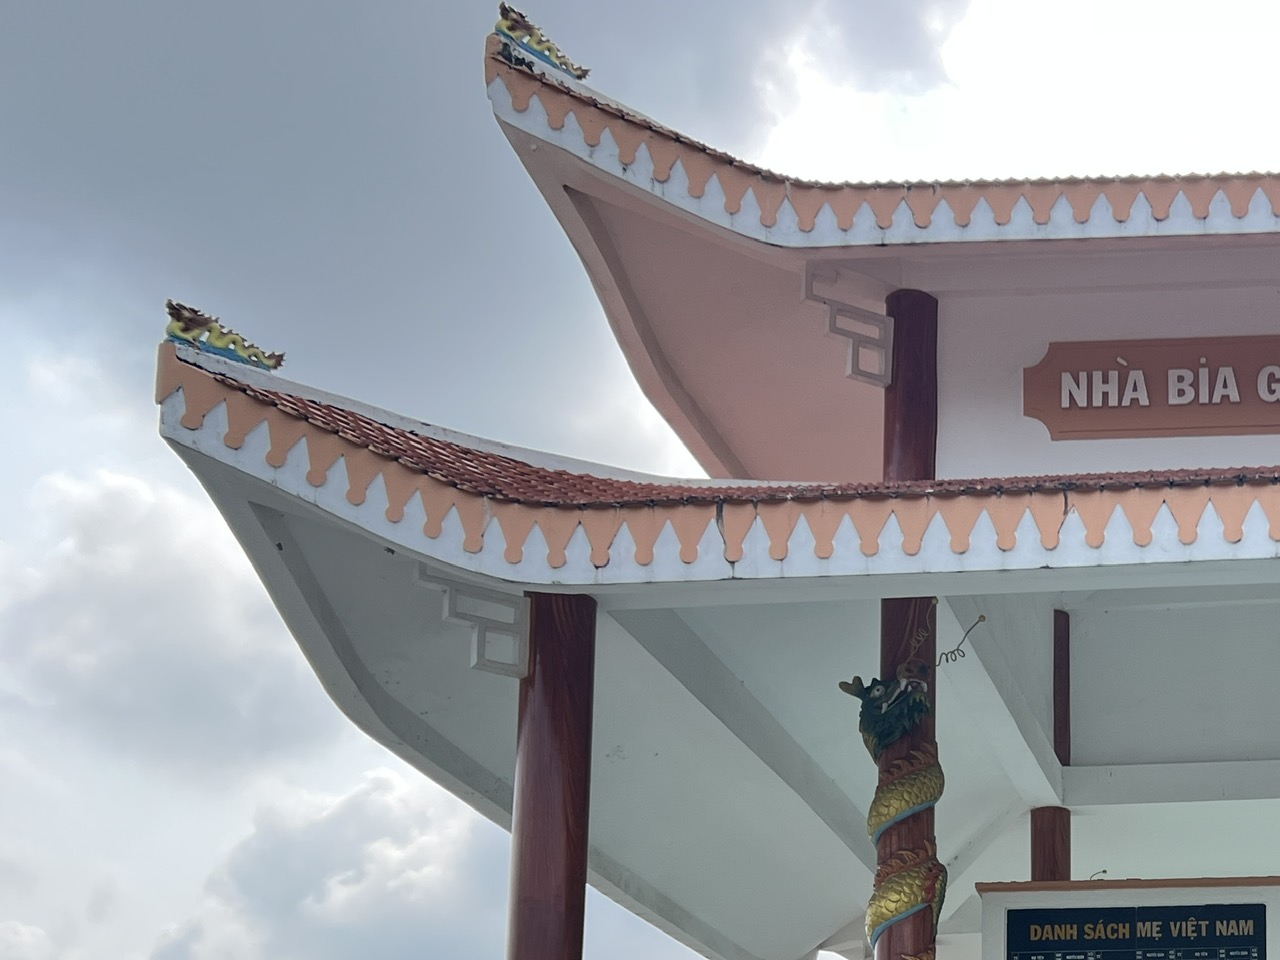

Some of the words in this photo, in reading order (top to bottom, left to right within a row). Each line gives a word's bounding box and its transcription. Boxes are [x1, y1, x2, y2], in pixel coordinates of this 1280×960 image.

[1060, 356, 1150, 408] NHÀ
[1167, 356, 1241, 405] BIA
[1030, 924, 1077, 941] DANH
[1084, 920, 1130, 939] SÁCH
[1137, 921, 1161, 941] MẸ
[1170, 917, 1209, 940] VIỆT
[1216, 919, 1254, 936] NAM
